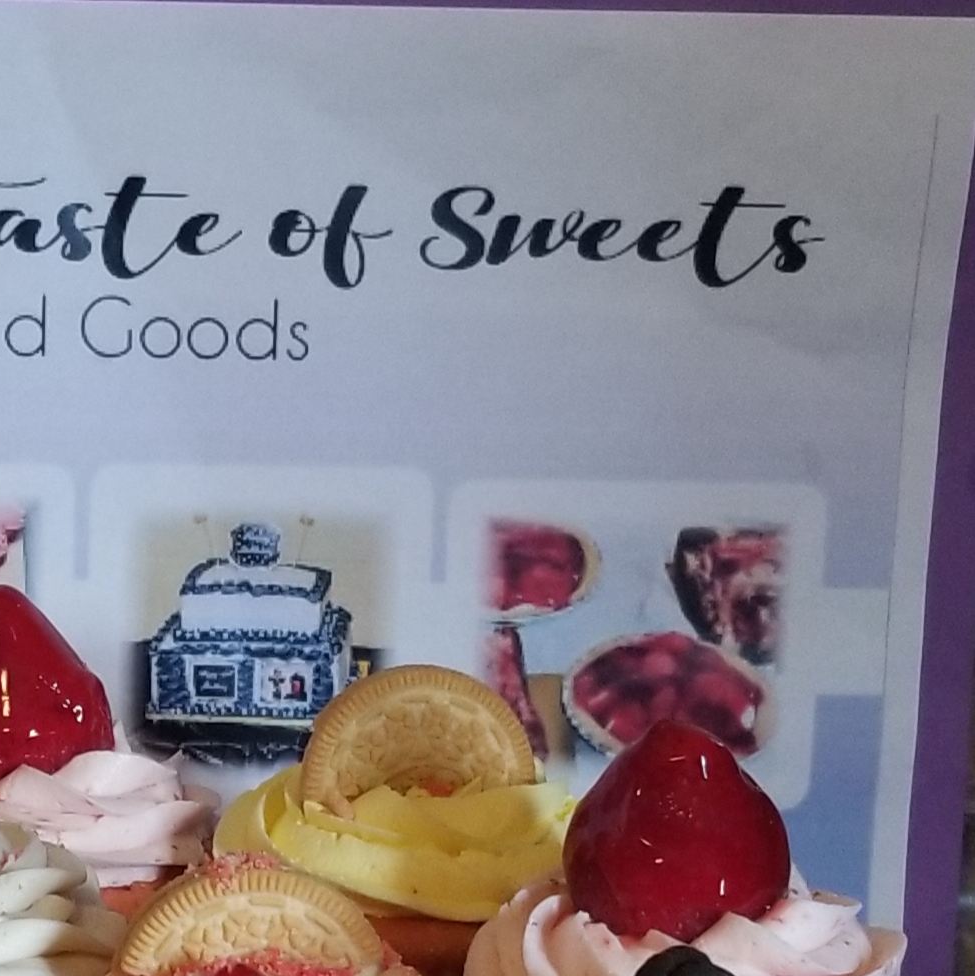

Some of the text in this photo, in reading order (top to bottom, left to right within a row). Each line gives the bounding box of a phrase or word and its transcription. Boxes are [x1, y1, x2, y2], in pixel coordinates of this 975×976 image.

[268, 184, 394, 290] of
[419, 185, 826, 289] Sweets
[80, 295, 309, 362] Goods
